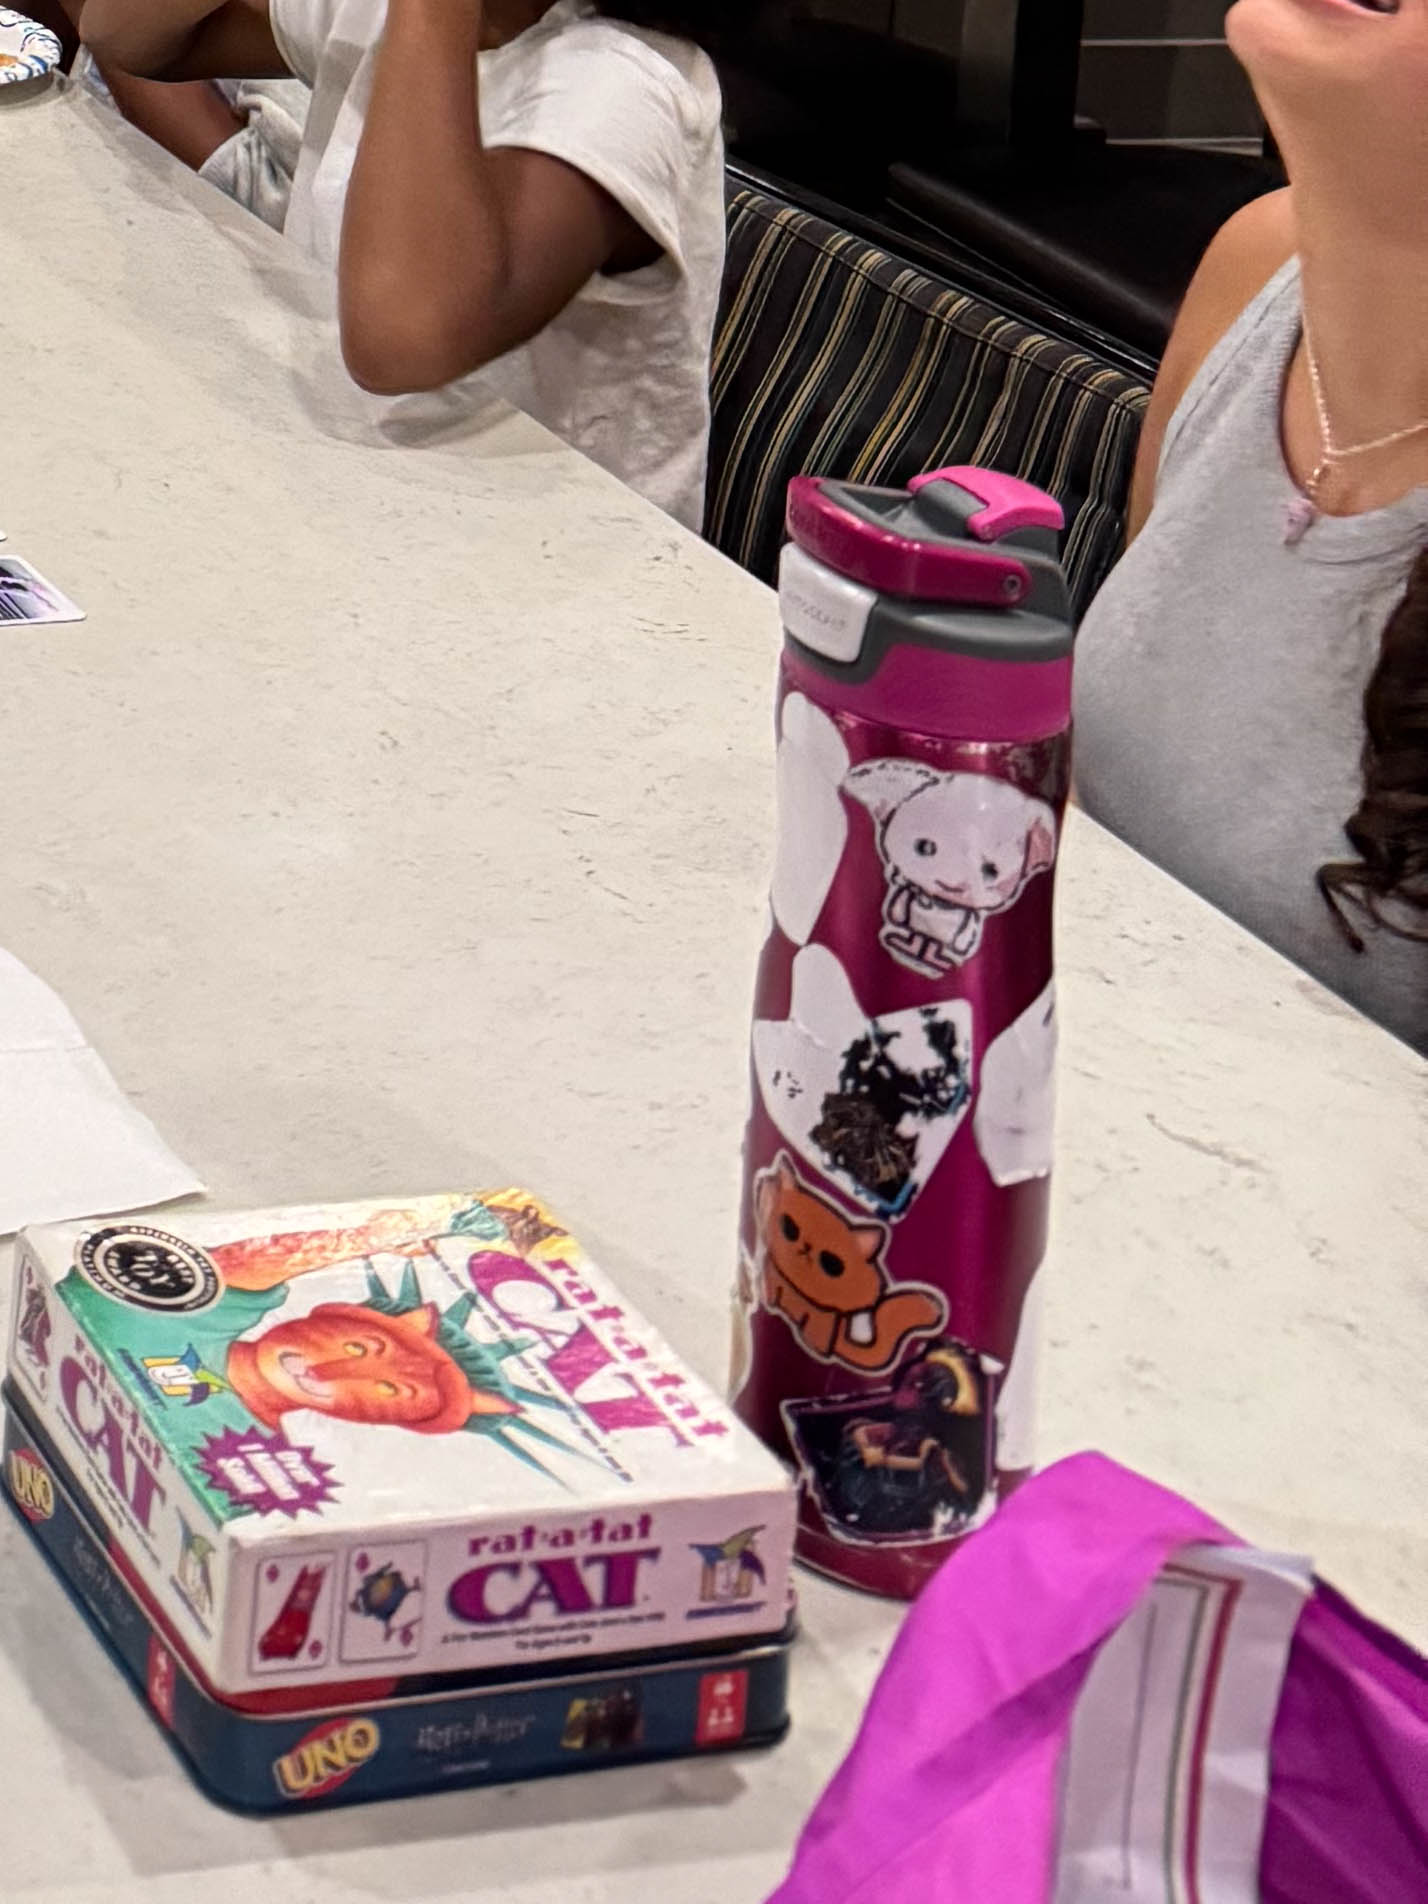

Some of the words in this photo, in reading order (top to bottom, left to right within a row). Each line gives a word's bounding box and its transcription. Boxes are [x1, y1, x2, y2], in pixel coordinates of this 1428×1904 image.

[467, 1249, 695, 1448] CAT
[59, 1355, 168, 1535] CAT
[10, 1453, 55, 1519] UNO
[446, 1546, 662, 1625] CAT
[274, 1718, 380, 1799] UNO
